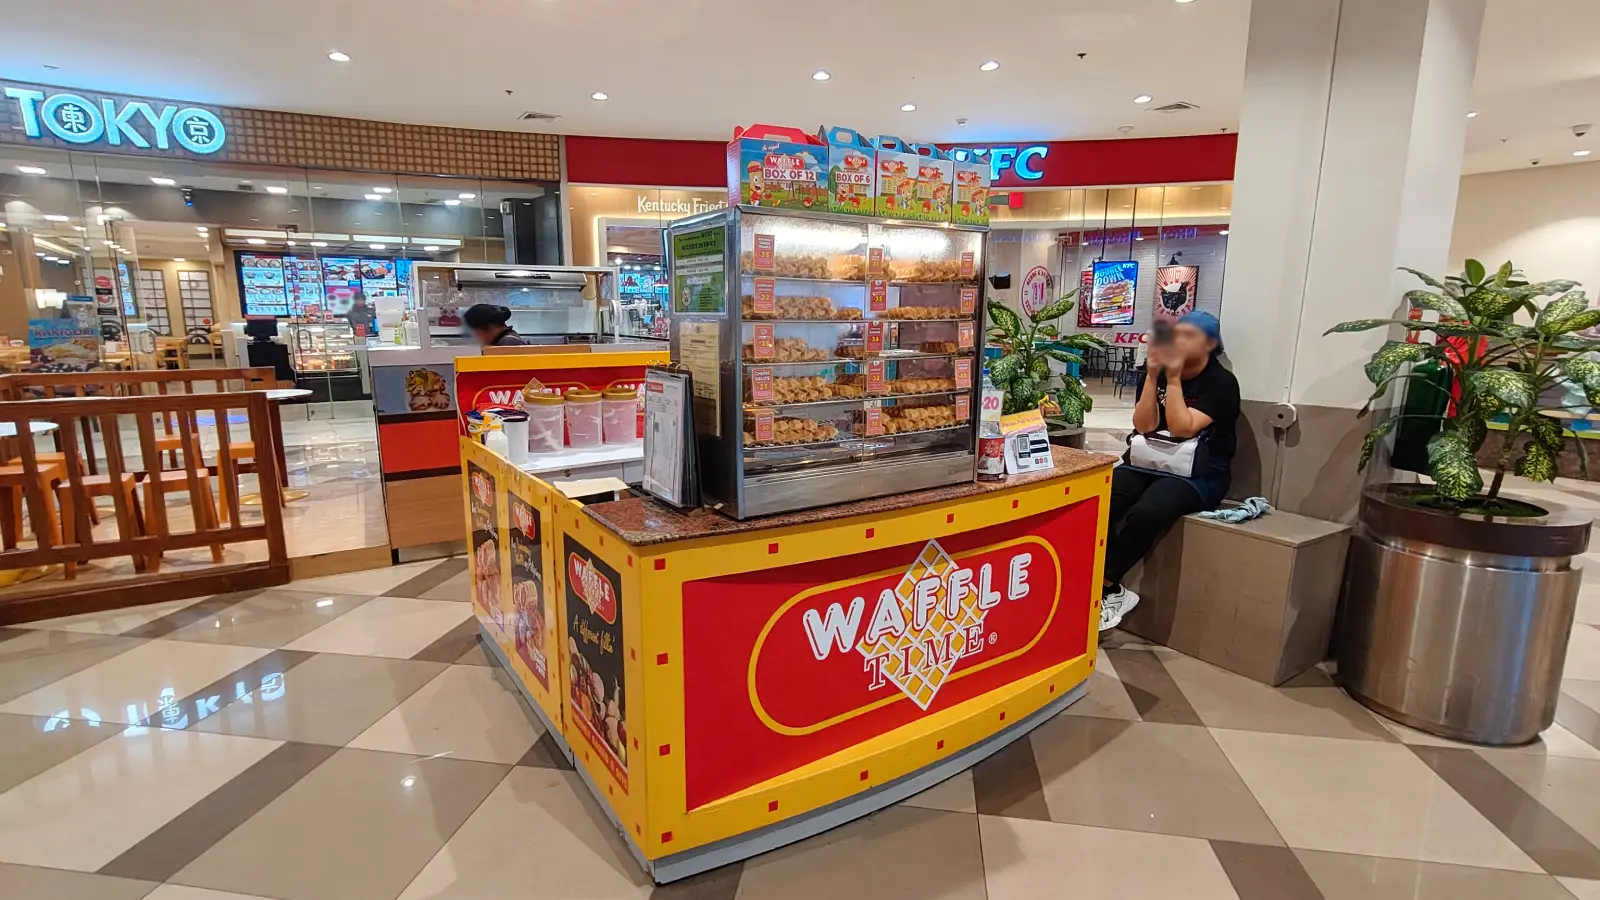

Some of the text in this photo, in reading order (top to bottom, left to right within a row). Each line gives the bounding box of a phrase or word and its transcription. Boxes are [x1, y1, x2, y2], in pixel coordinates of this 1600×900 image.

[4, 87, 226, 154] TOKYO
[765, 169, 814, 180] BOX OF 12
[836, 173, 871, 183] BOX OF 6
[638, 195, 690, 219] Kentucky
[1094, 264, 1124, 279] DOUBLE
[1096, 270, 1125, 287] DOWN
[1114, 332, 1149, 343] KFC
[983, 396, 999, 410] 20
[803, 552, 1032, 660] WAFFLE
[863, 619, 984, 691] TIME
